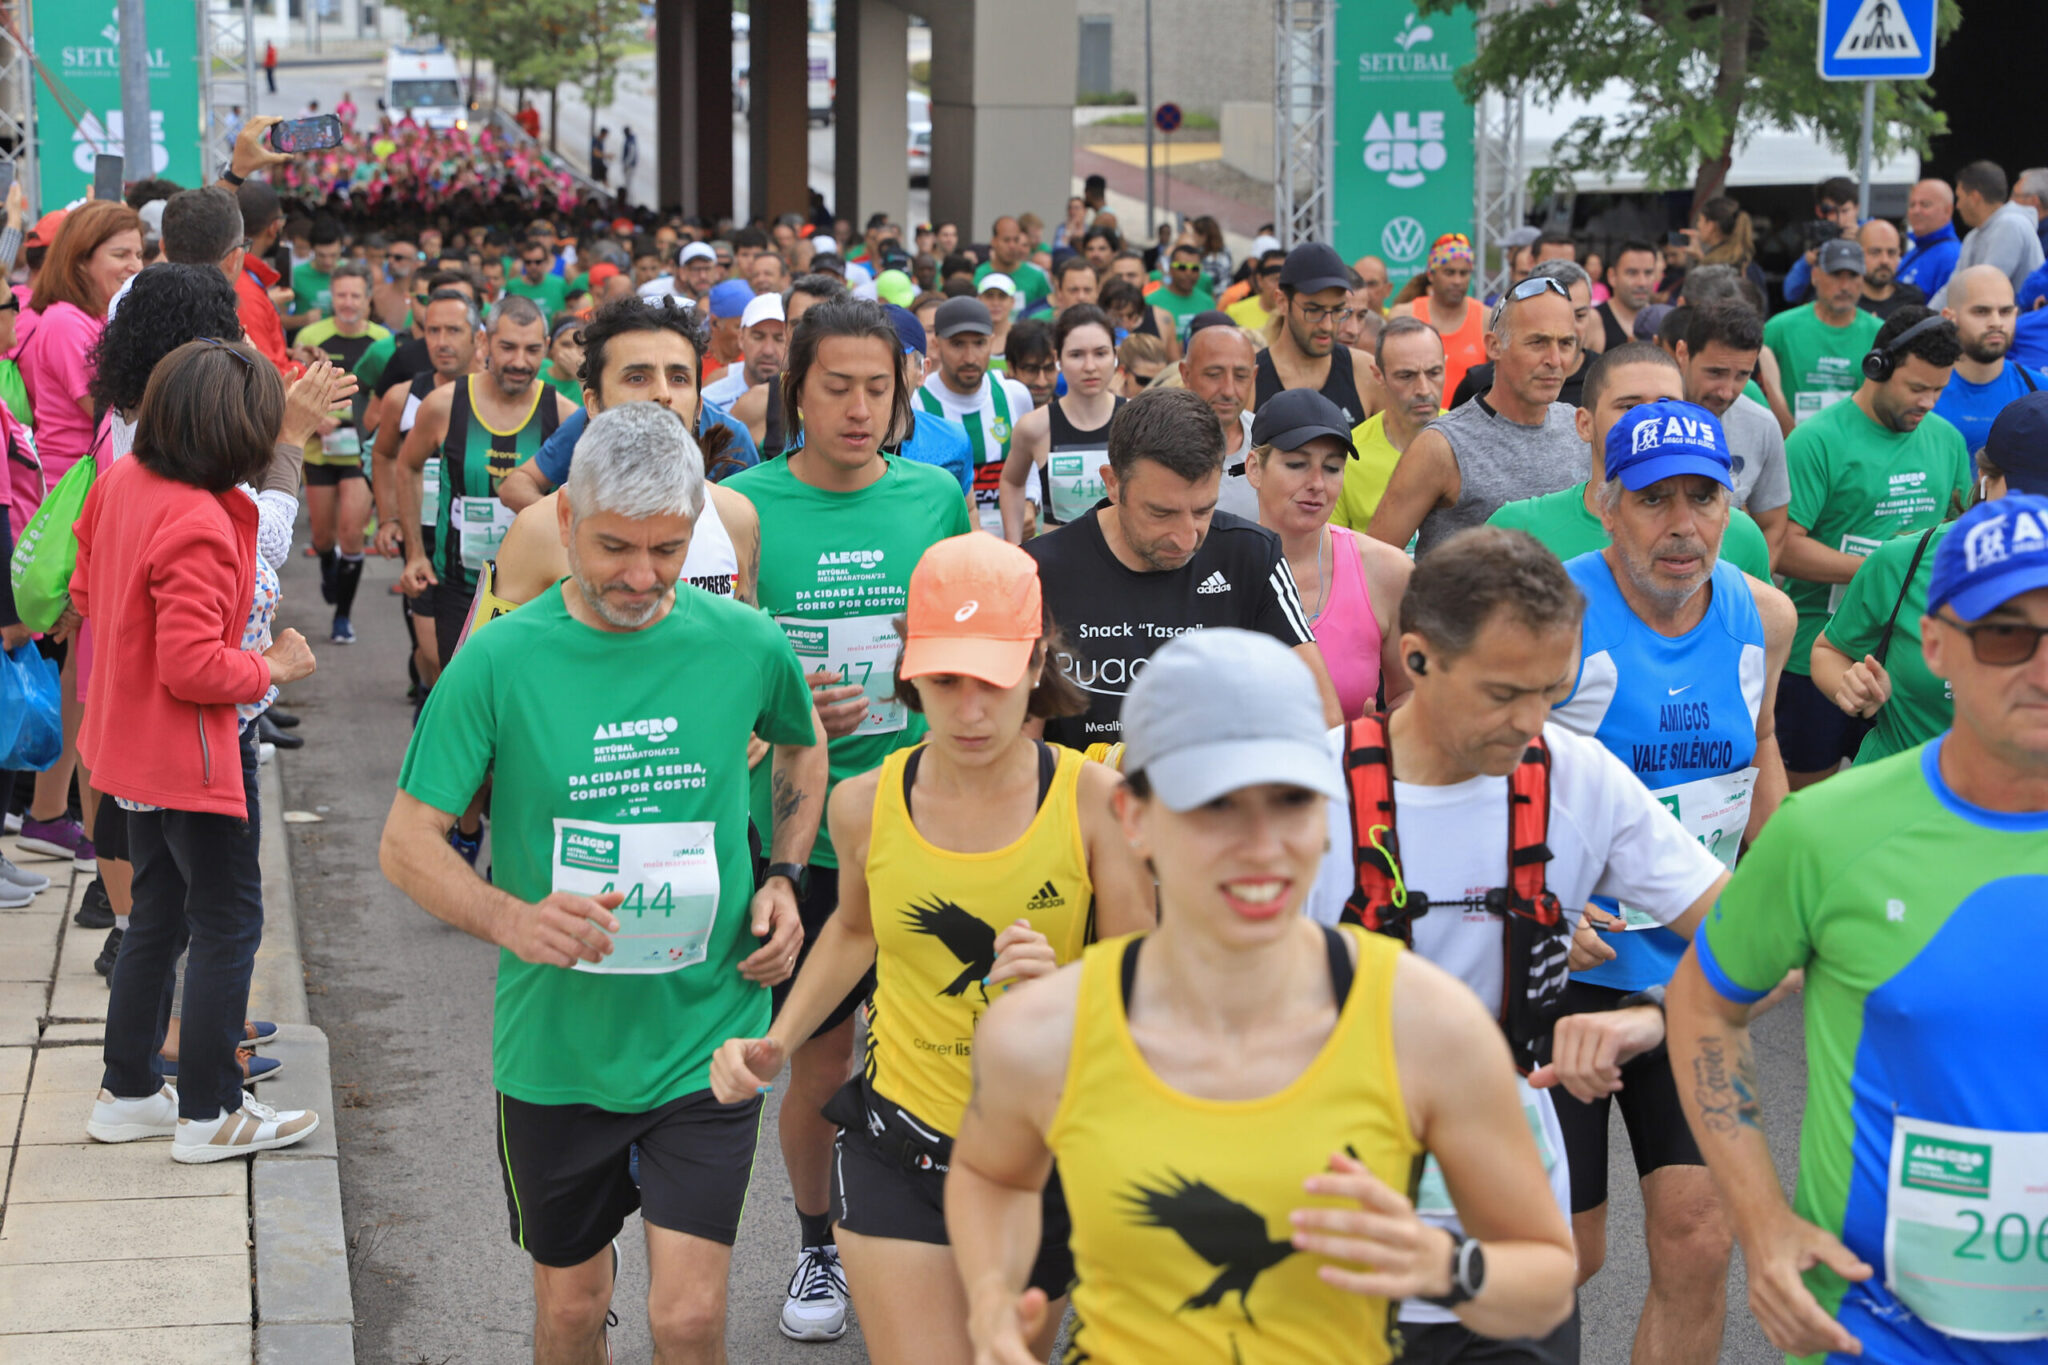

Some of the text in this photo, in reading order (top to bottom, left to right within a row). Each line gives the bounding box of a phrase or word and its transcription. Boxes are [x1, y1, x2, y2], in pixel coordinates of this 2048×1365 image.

[62, 47, 170, 67] SETUAL
[1363, 111, 1444, 141] ALE
[1363, 141, 1447, 171] GRO
[1664, 416, 1715, 443] AVS
[817, 550, 884, 569] ALEGRO
[796, 591, 811, 599] DA
[814, 588, 855, 598] CIDADE
[867, 586, 906, 595] SERRA,
[1197, 584, 1231, 594] adidas
[796, 597, 905, 611] CORRO POR GOSTO!
[786, 629, 824, 643] ALEGRO
[1079, 622, 1134, 638] Snack
[1659, 702, 1710, 732] AMIGOS
[593, 717, 678, 741] ALEGRO
[594, 747, 680, 763] MEIA MARATONA'22
[1633, 736, 1733, 773] VALE SILÊNCIO
[569, 762, 706, 786] DA CIDADE À SERRA,
[570, 786, 617, 801] CORRO
[621, 782, 649, 795] POR
[653, 777, 706, 791] GOSTO!
[567, 834, 614, 851] ALEGRO
[1027, 898, 1065, 911] adidas
[914, 1037, 953, 1056] correr
[1911, 1144, 1984, 1167] ALEGRO
